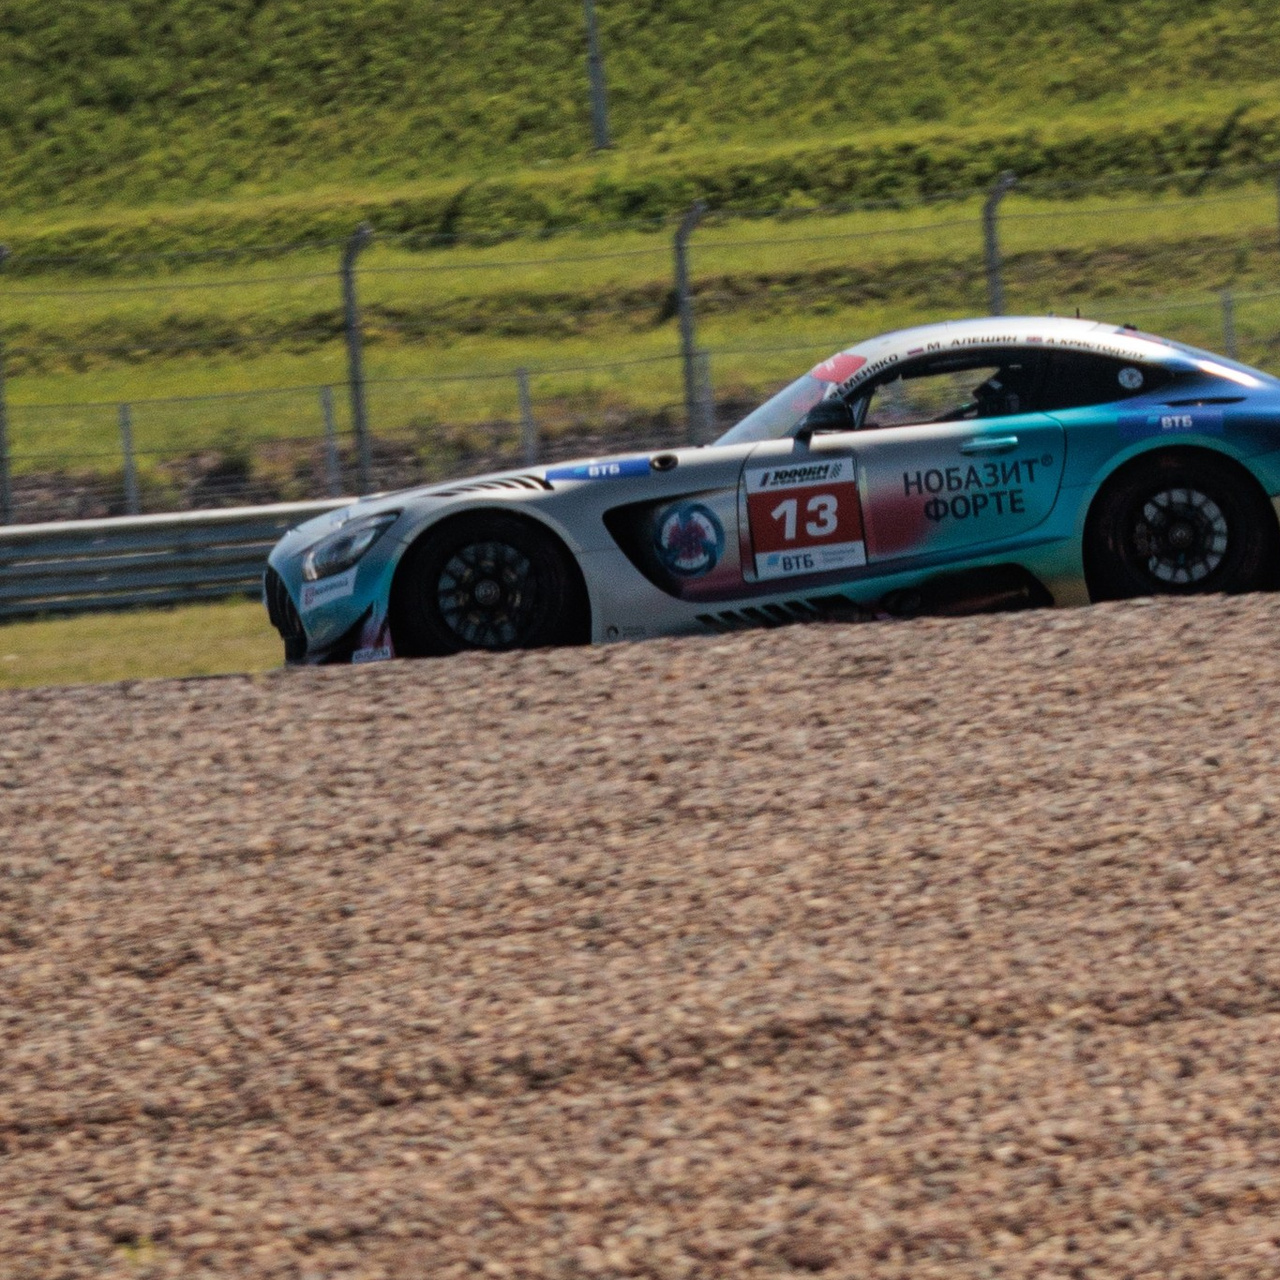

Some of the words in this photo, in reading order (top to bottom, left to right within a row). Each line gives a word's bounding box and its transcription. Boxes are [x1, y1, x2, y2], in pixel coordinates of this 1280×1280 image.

[1161, 415, 1193, 428] ВТБ
[588, 463, 620, 477] ВТБ
[903, 458, 1040, 496] НОБАЗИТ
[771, 494, 838, 540] 13
[924, 489, 1025, 522] ФОРТЕ
[782, 553, 814, 571] ВТБ
